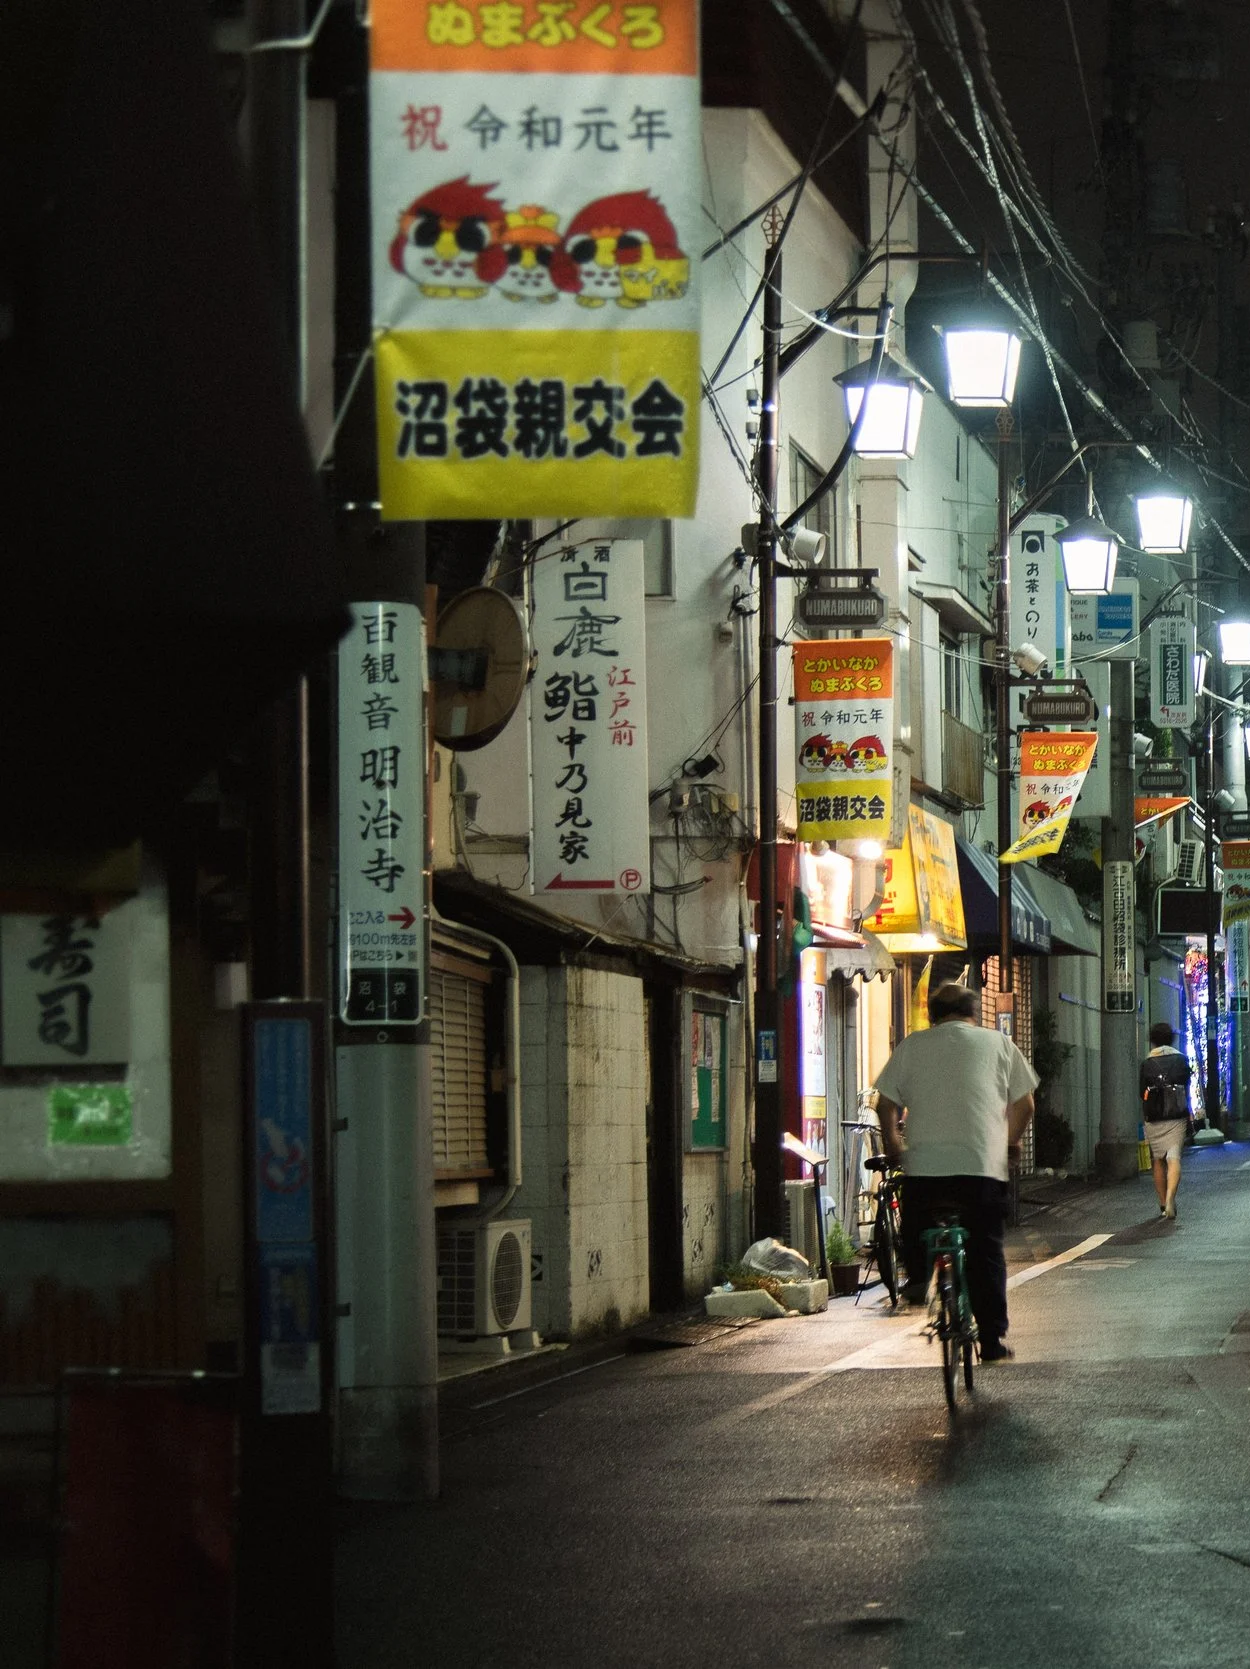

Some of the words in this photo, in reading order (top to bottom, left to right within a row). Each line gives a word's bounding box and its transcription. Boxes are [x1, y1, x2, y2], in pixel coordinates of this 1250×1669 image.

[426, 3, 664, 48] ぬまぶくろ
[401, 104, 448, 151] 祝
[463, 103, 672, 152] 令和元年
[396, 377, 685, 459] 沼袋親交会
[553, 561, 623, 658] 白鹿
[806, 599, 878, 616] NUMABUKURO
[1025, 562, 1041, 640] お茶とのり
[803, 656, 879, 673] とかいなか
[1166, 645, 1180, 705] さわた医院
[810, 676, 883, 693] ぬまぶくろ
[608, 665, 637, 746] 江戸前
[802, 711, 816, 727] 祝
[820, 708, 884, 725] 令和元年
[1031, 702, 1086, 715] NUMABUKURO
[1029, 744, 1087, 757] とかいなか
[1026, 783, 1037, 796] 祝
[800, 795, 885, 822] 沼袋親交会
